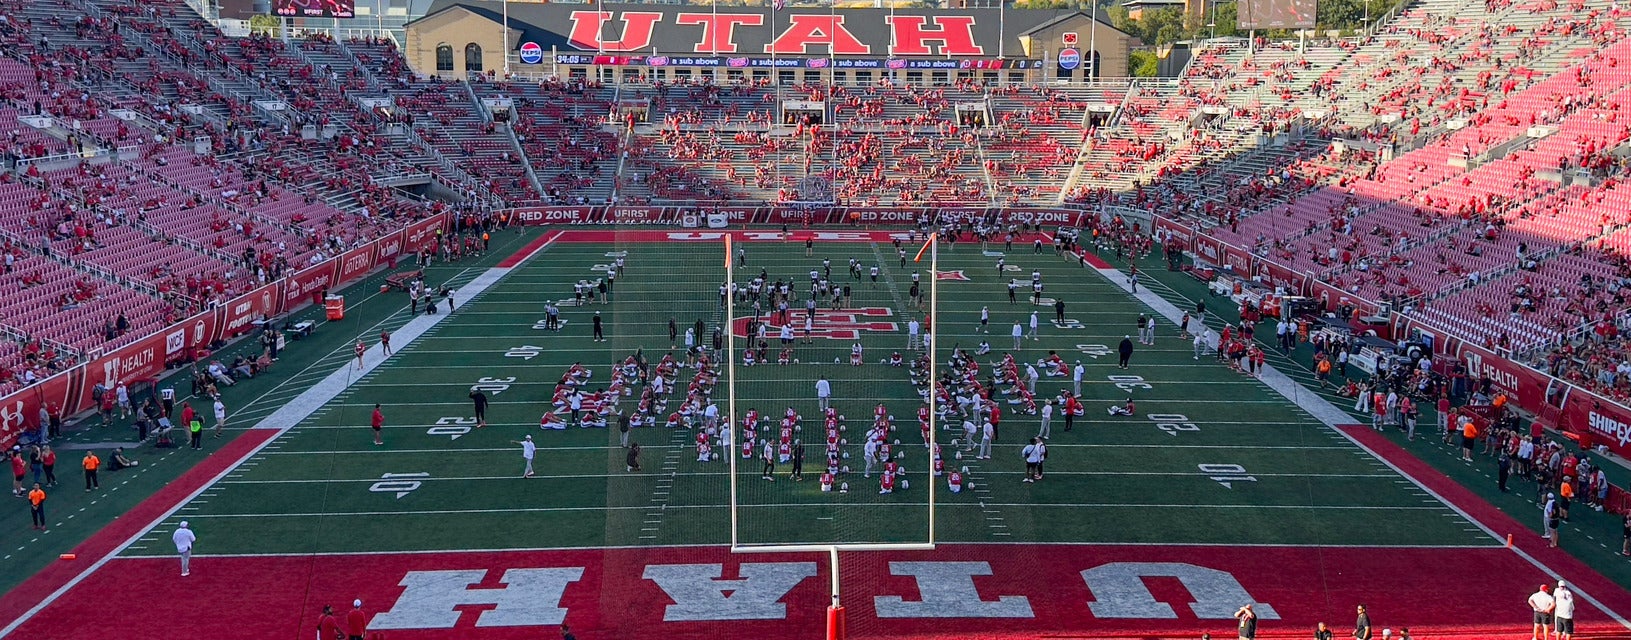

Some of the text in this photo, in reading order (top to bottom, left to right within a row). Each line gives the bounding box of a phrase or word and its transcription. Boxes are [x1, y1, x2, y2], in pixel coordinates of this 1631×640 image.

[567, 10, 984, 55] UTAH
[557, 55, 579, 64] 34:05
[679, 57, 693, 65] sub
[695, 58, 718, 66] above
[854, 59, 877, 67] above
[933, 60, 955, 68] above
[519, 209, 580, 221] RED ZONE
[614, 209, 649, 218] UFIRST
[879, 211, 914, 221] ZONE
[1010, 212, 1070, 222] RED ZONE
[168, 333, 183, 350] WCF
[121, 346, 154, 375] HEALTH
[470, 376, 517, 391] 30
[1106, 375, 1153, 390] 30
[1483, 362, 1518, 392] HEALTH
[426, 416, 478, 435] 20
[1147, 414, 1201, 431] 20
[1197, 464, 1258, 482] 10
[368, 472, 430, 492] 10
[366, 562, 1282, 630] UTAH
